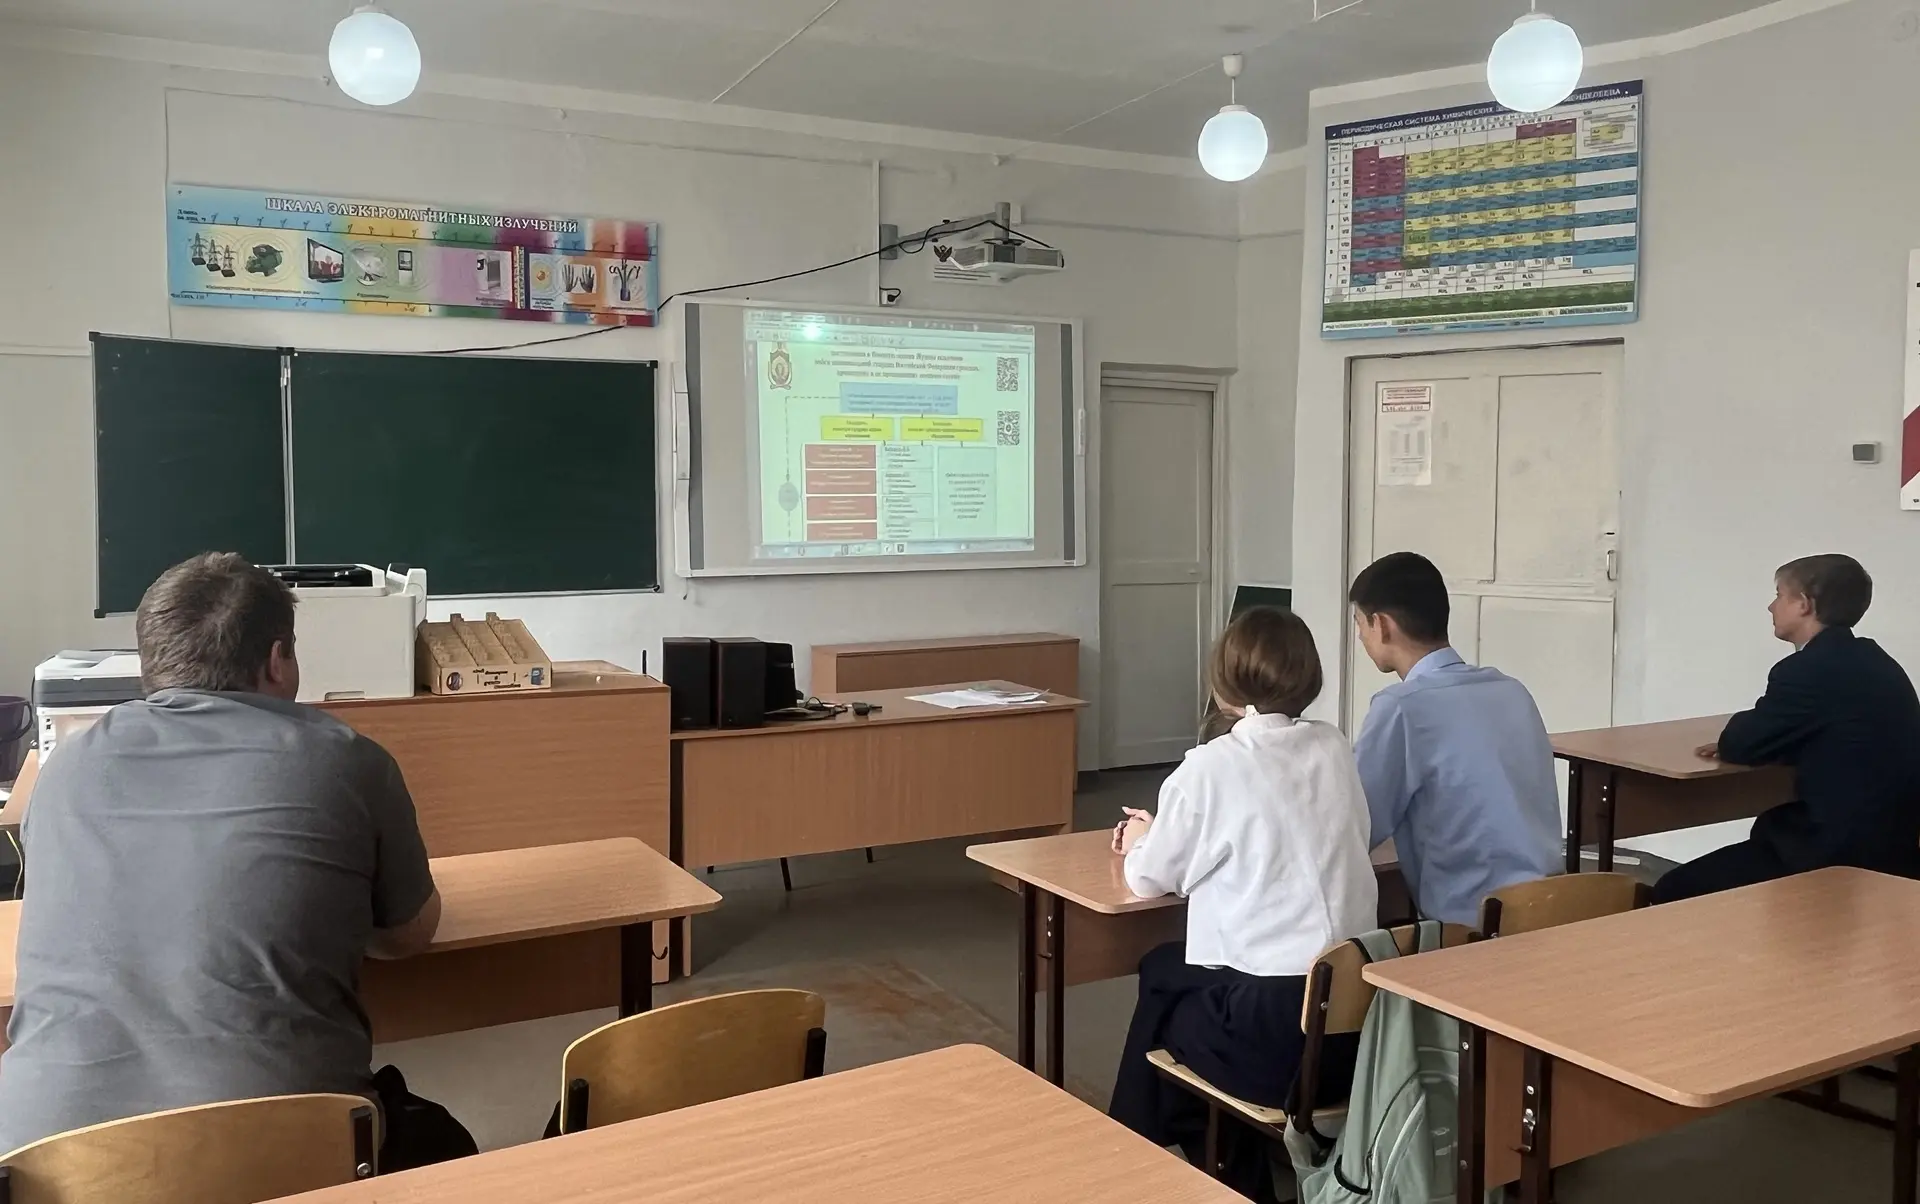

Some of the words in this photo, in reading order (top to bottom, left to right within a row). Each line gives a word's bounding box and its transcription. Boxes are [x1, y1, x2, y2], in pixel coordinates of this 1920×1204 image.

[1341, 121, 1403, 135] ПЕРИОДИЧЕСКАЯ
[1405, 115, 1441, 127] СИСТЕМА
[1442, 106, 1494, 121] ХИМИЧЕСКИХ
[265, 197, 324, 214] ШКАЛА
[327, 203, 491, 226] ЭЛЕКТРОМАГНИТНЫХ
[493, 216, 578, 233] ИЗЛУЧЕНИЙ
